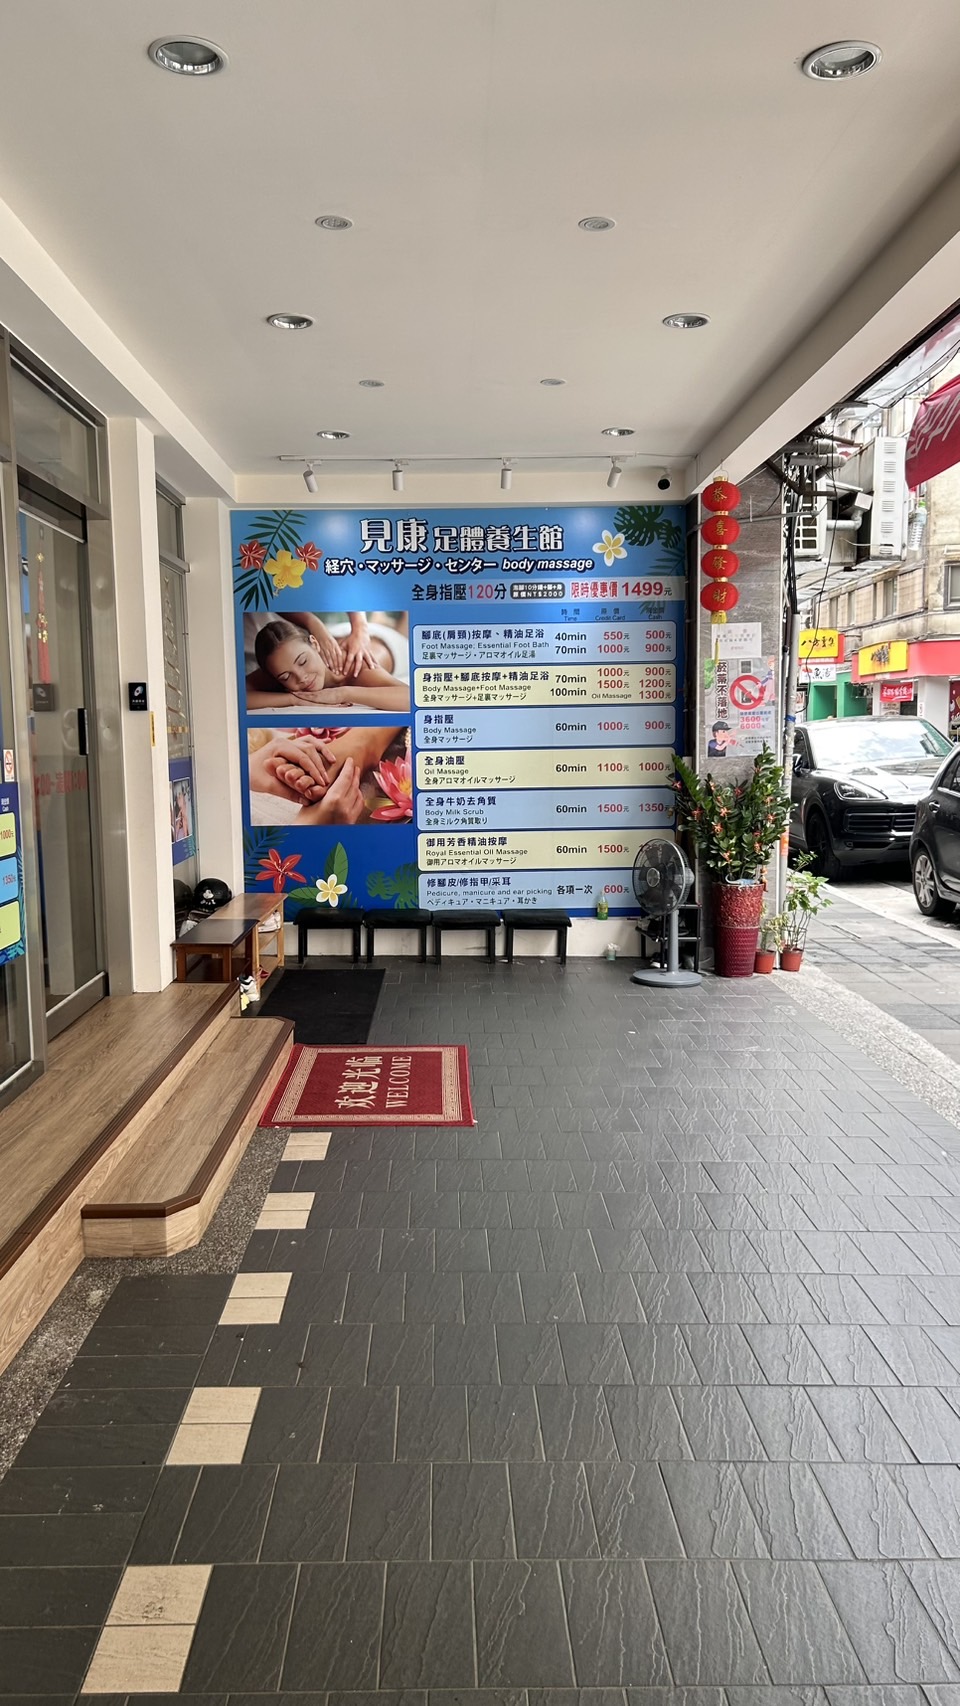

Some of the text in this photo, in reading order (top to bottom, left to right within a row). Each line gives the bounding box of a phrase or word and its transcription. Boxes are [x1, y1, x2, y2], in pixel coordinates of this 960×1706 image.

[360, 518, 563, 553] 見康 足體養生館
[325, 557, 497, 575] 経穴・マッサージ・センター
[502, 558, 593, 572] body massage
[411, 583, 507, 601] 全身指壓120分
[571, 581, 673, 598] 限時優惠價 1499元
[555, 630, 672, 641] 40min 550元 500元
[478, 641, 512, 649] Essential
[555, 643, 672, 654] 70min 1000元 900元
[597, 667, 672, 677] 1000元 900元
[555, 674, 587, 683] 70min
[499, 684, 532, 692] Massage
[597, 679, 672, 689] 1500元 1200元
[550, 688, 587, 696] 100min
[639, 690, 672, 699] 1300元
[423, 714, 454, 724] 身指壓
[444, 727, 477, 735] Massage
[555, 721, 672, 731] 60min 1000元 900元
[424, 735, 473, 744] 全身マッサージ
[424, 756, 465, 766] 全身油壓
[436, 768, 469, 776] Massage
[555, 762, 672, 772] 60min 1100元 1000元
[424, 775, 516, 785] 全身アロマオイルマッサージ
[425, 796, 497, 807] 全身牛奶去角質
[556, 804, 587, 813] 60min
[597, 804, 630, 813] 1500元
[426, 816, 488, 826] 全身ミルク角質取り
[426, 837, 508, 847] 御用芳香精油按摩
[496, 849, 528, 857] Massage
[556, 845, 588, 853] 60min
[597, 844, 630, 853] 1500元
[426, 857, 517, 866] 御用アロマオイルマッサージ
[527, 888, 553, 896] picking
[557, 885, 630, 895] 各項一次 600元
[385, 1056, 412, 1108] WELCOME
